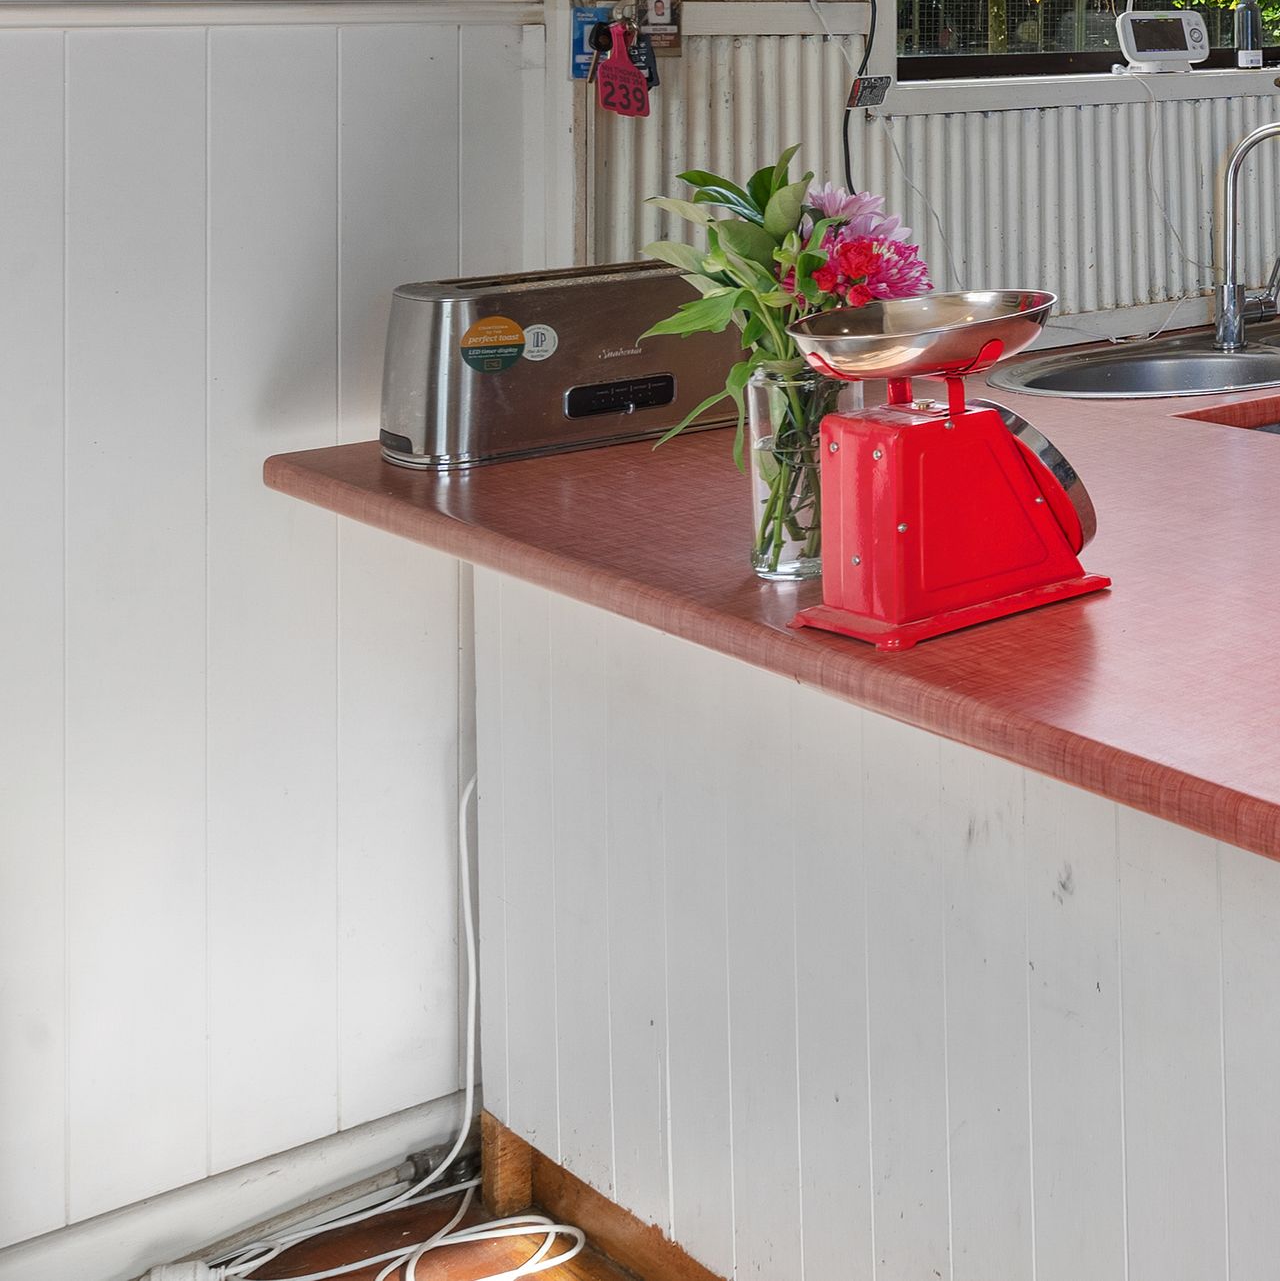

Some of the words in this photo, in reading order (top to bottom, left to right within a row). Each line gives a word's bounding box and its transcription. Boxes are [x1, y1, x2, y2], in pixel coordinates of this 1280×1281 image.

[603, 80, 646, 112] 239
[468, 334, 498, 345] perfect
[499, 333, 520, 341] toast
